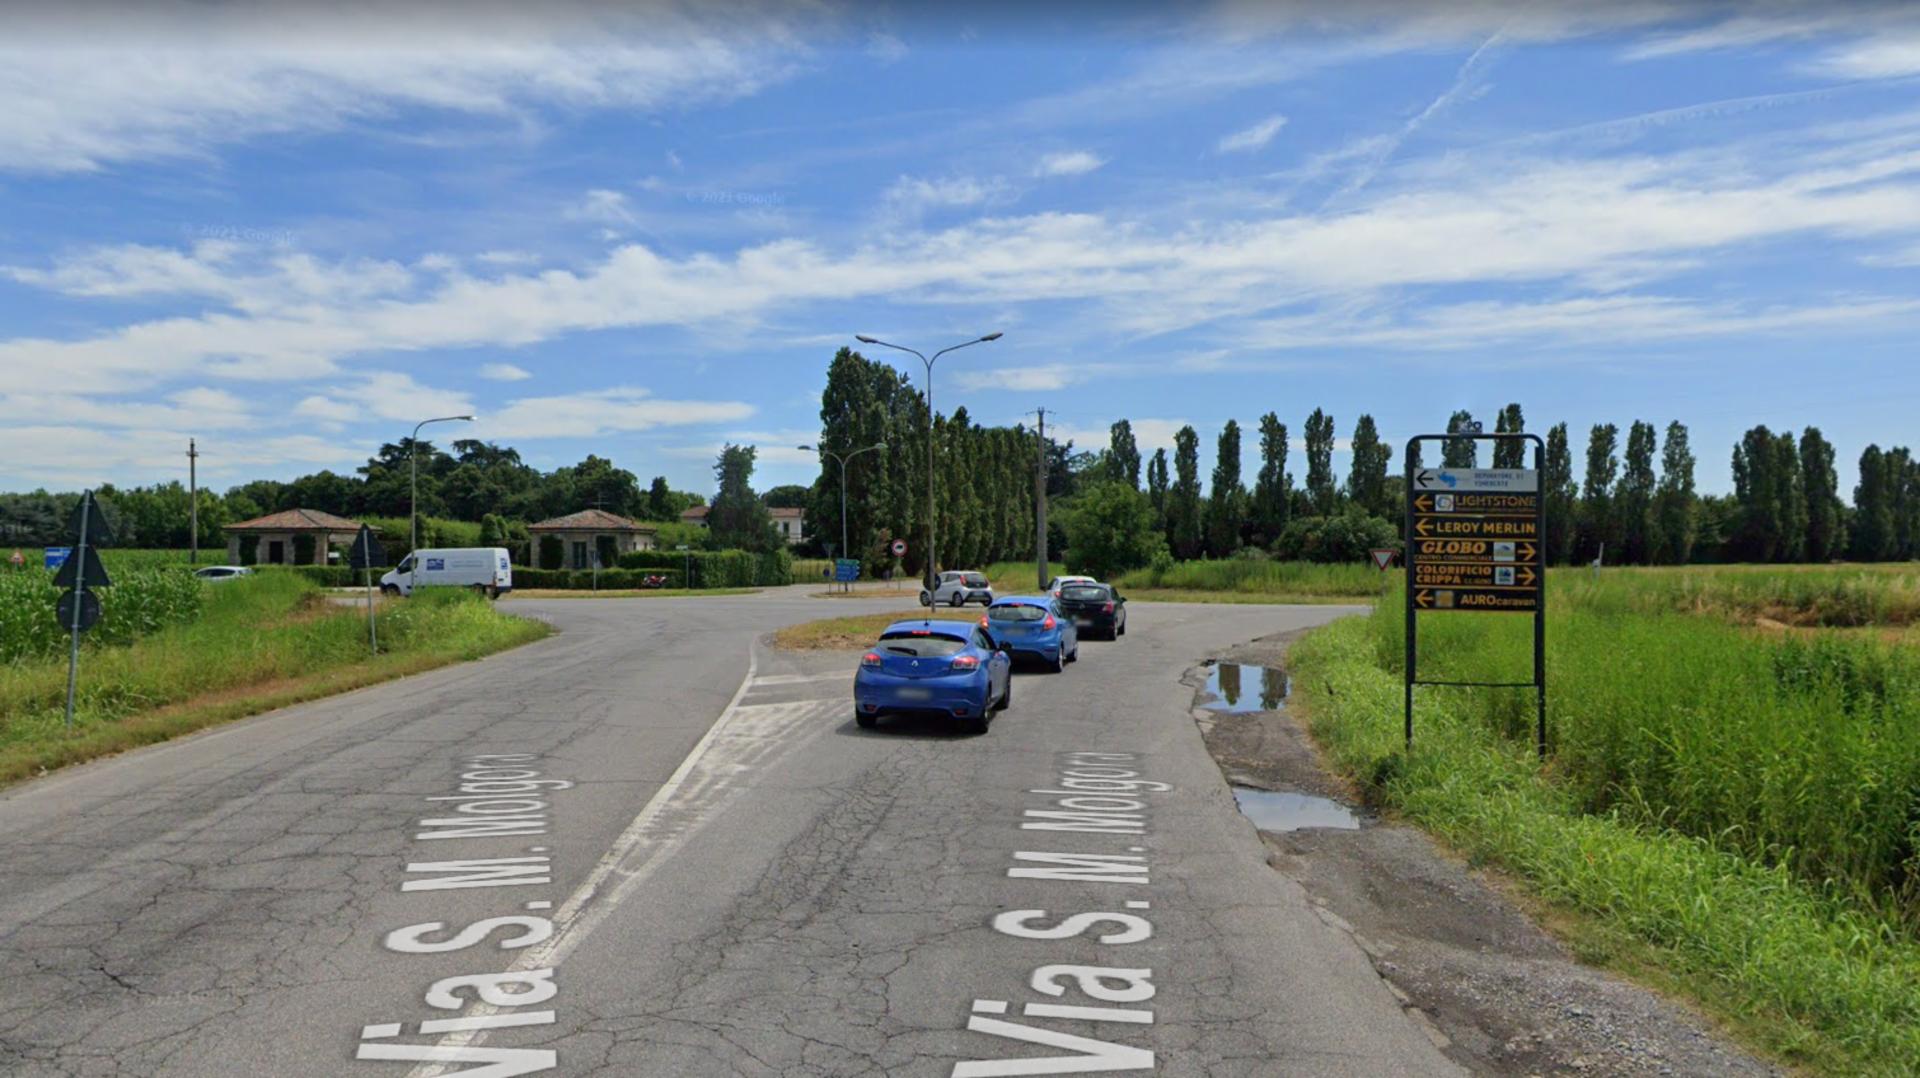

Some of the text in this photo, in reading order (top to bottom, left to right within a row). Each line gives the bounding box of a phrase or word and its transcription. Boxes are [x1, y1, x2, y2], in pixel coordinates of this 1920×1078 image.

[1455, 495, 1536, 506] LIGHTSTONE
[1437, 522, 1536, 534] LEROY MERLIN
[1421, 541, 1486, 554] GLOBO
[1416, 565, 1492, 575] COLORIFICIO
[1416, 574, 1462, 584] CRIPPA
